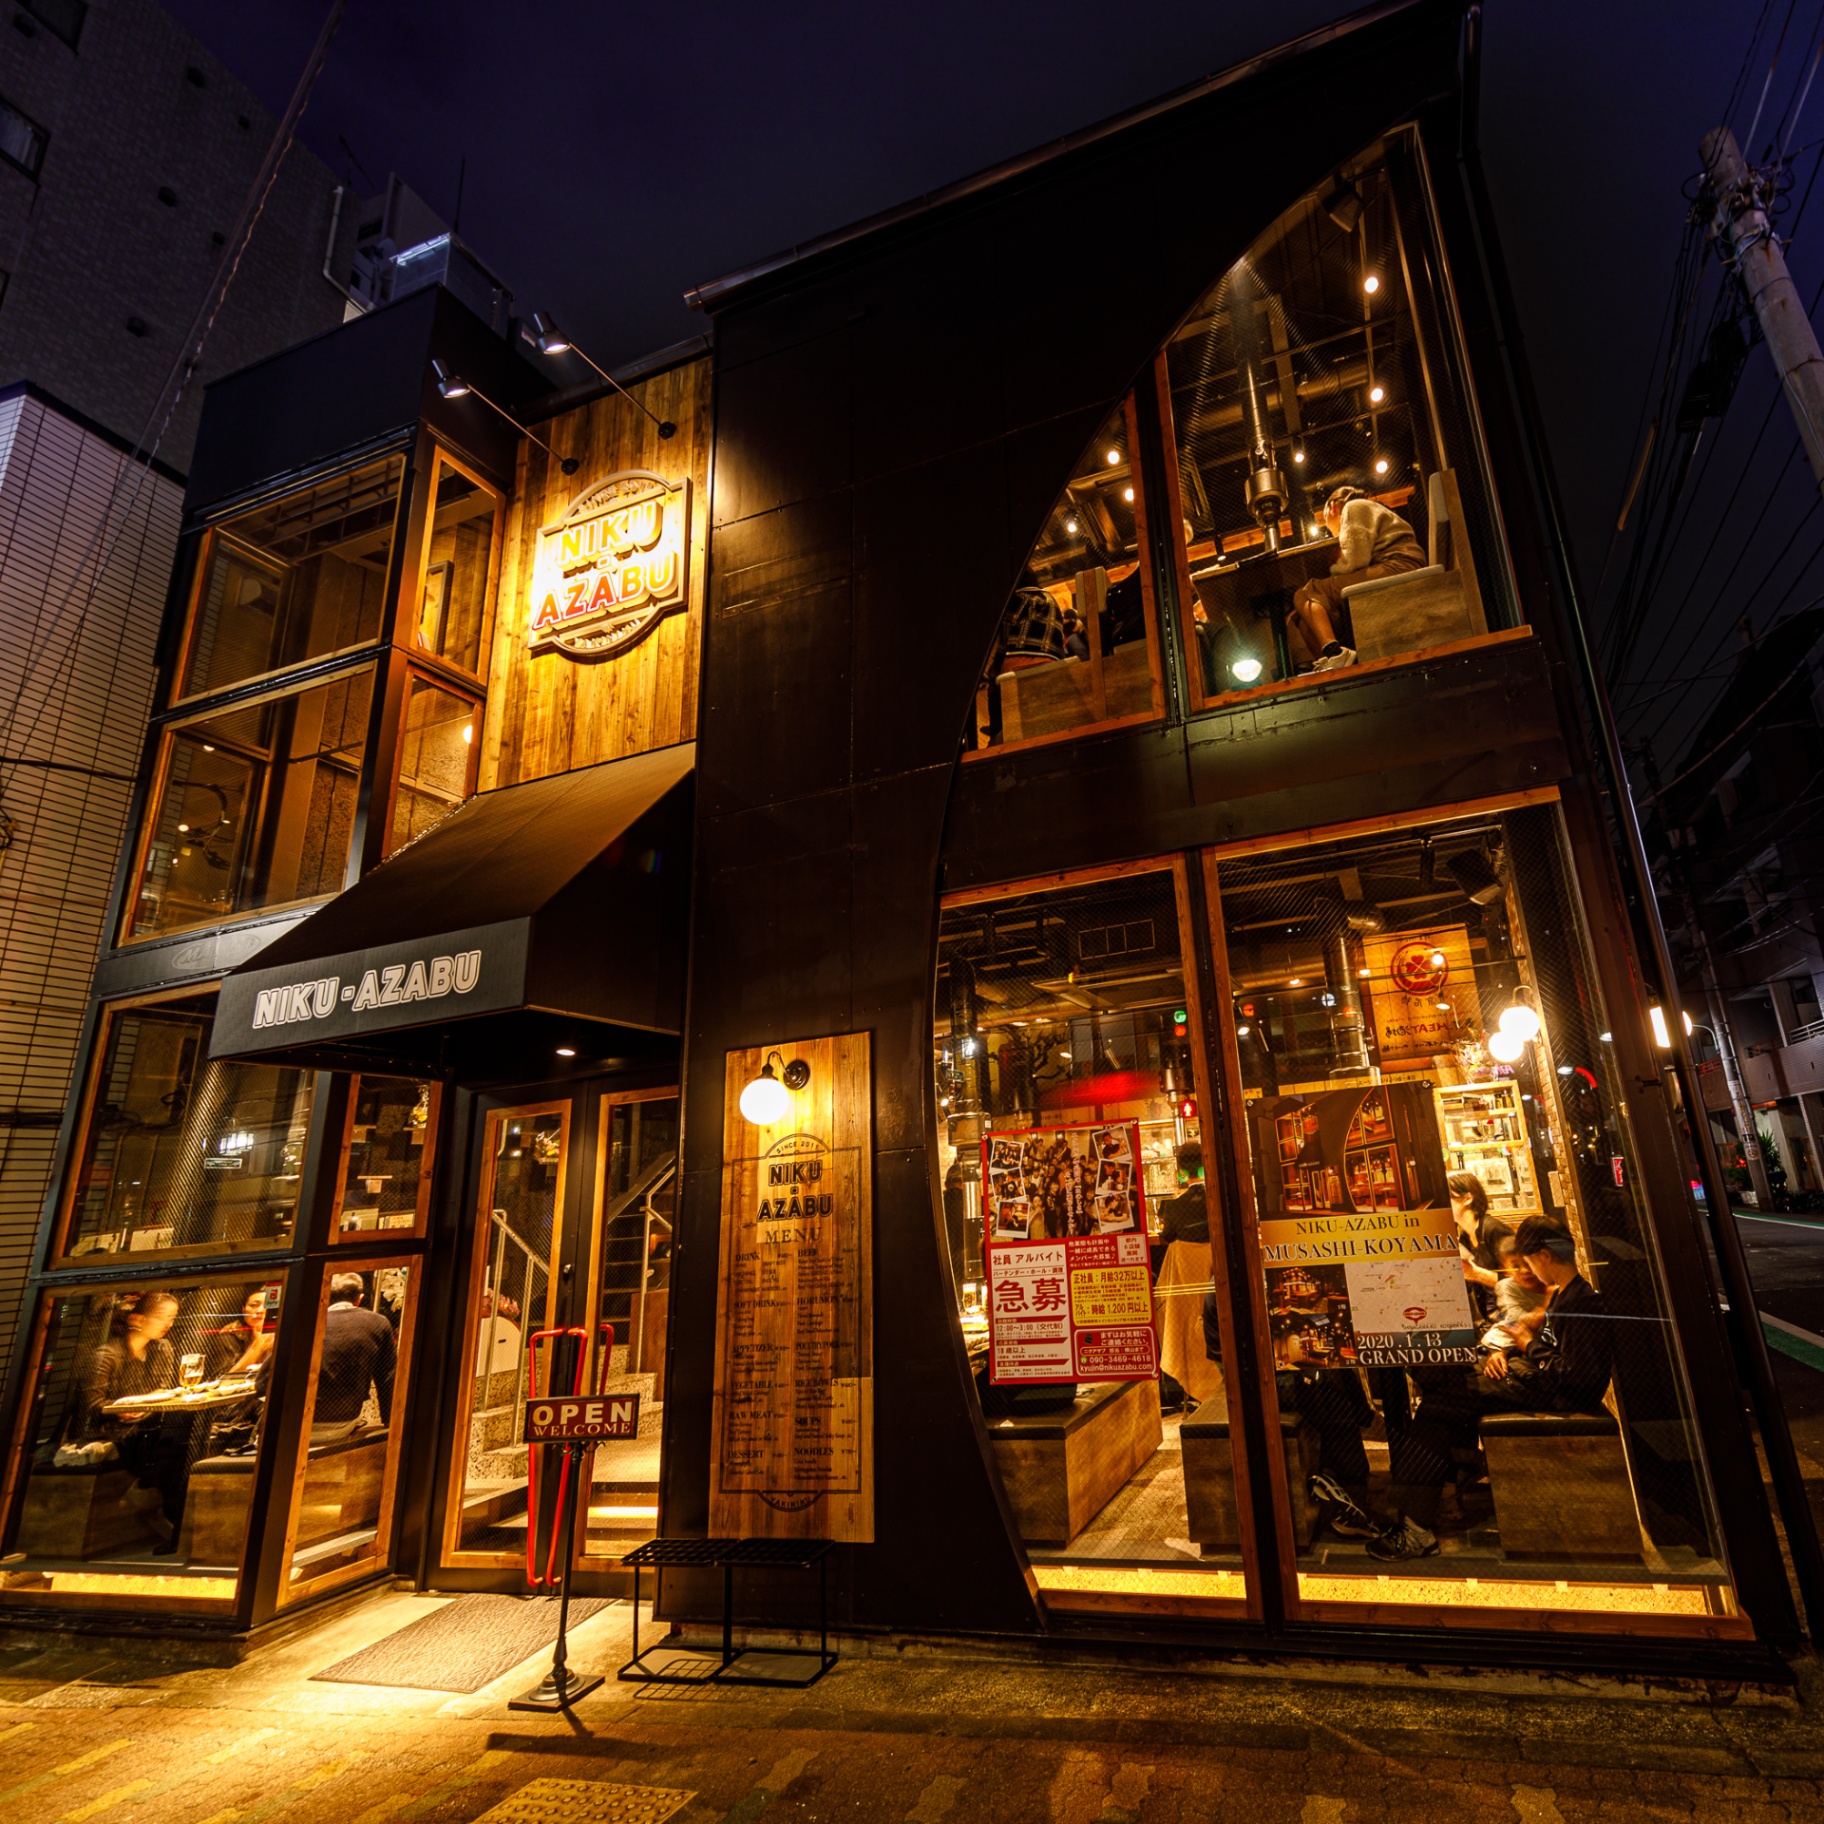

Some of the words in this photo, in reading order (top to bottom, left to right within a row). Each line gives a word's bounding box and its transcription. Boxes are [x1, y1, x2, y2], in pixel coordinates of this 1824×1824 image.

[557, 500, 662, 566] NIKU
[532, 551, 678, 630] AZABU
[776, 1141, 797, 1154] SINCE
[800, 1141, 819, 1150] 2011
[768, 1159, 823, 1186] NIKU
[757, 1193, 834, 1222] AZABU
[1296, 1215, 1400, 1235] NIKU-AZABU
[1404, 1215, 1421, 1228] in
[765, 1227, 822, 1245] MENU
[798, 1248, 818, 1257] BEEF
[1264, 1233, 1460, 1262] MUSASHI-KOYAMA
[735, 1252, 760, 1261] DRINK
[993, 1254, 1011, 1266] 社員
[1014, 1251, 1063, 1264] アルバイト
[994, 1277, 1067, 1313] 急募
[753, 1299, 776, 1308] DRINK
[1100, 1331, 1148, 1339] まずはお気軽に
[732, 1344, 772, 1352] APPETIZER
[1359, 1348, 1424, 1365] GRAND
[1428, 1346, 1478, 1363] OPEN
[1080, 1363, 1153, 1373] kyujin@nikuazabu.com
[731, 1380, 773, 1389] VEGETABLE
[532, 1401, 633, 1426] OPEN
[729, 1411, 746, 1420] RAW
[750, 1411, 772, 1419] MEAT
[795, 1416, 821, 1425] SOUPS
[533, 1422, 631, 1437] WELCOME
[728, 1450, 763, 1459] DESSERT
[794, 1447, 834, 1456] NOODLES
